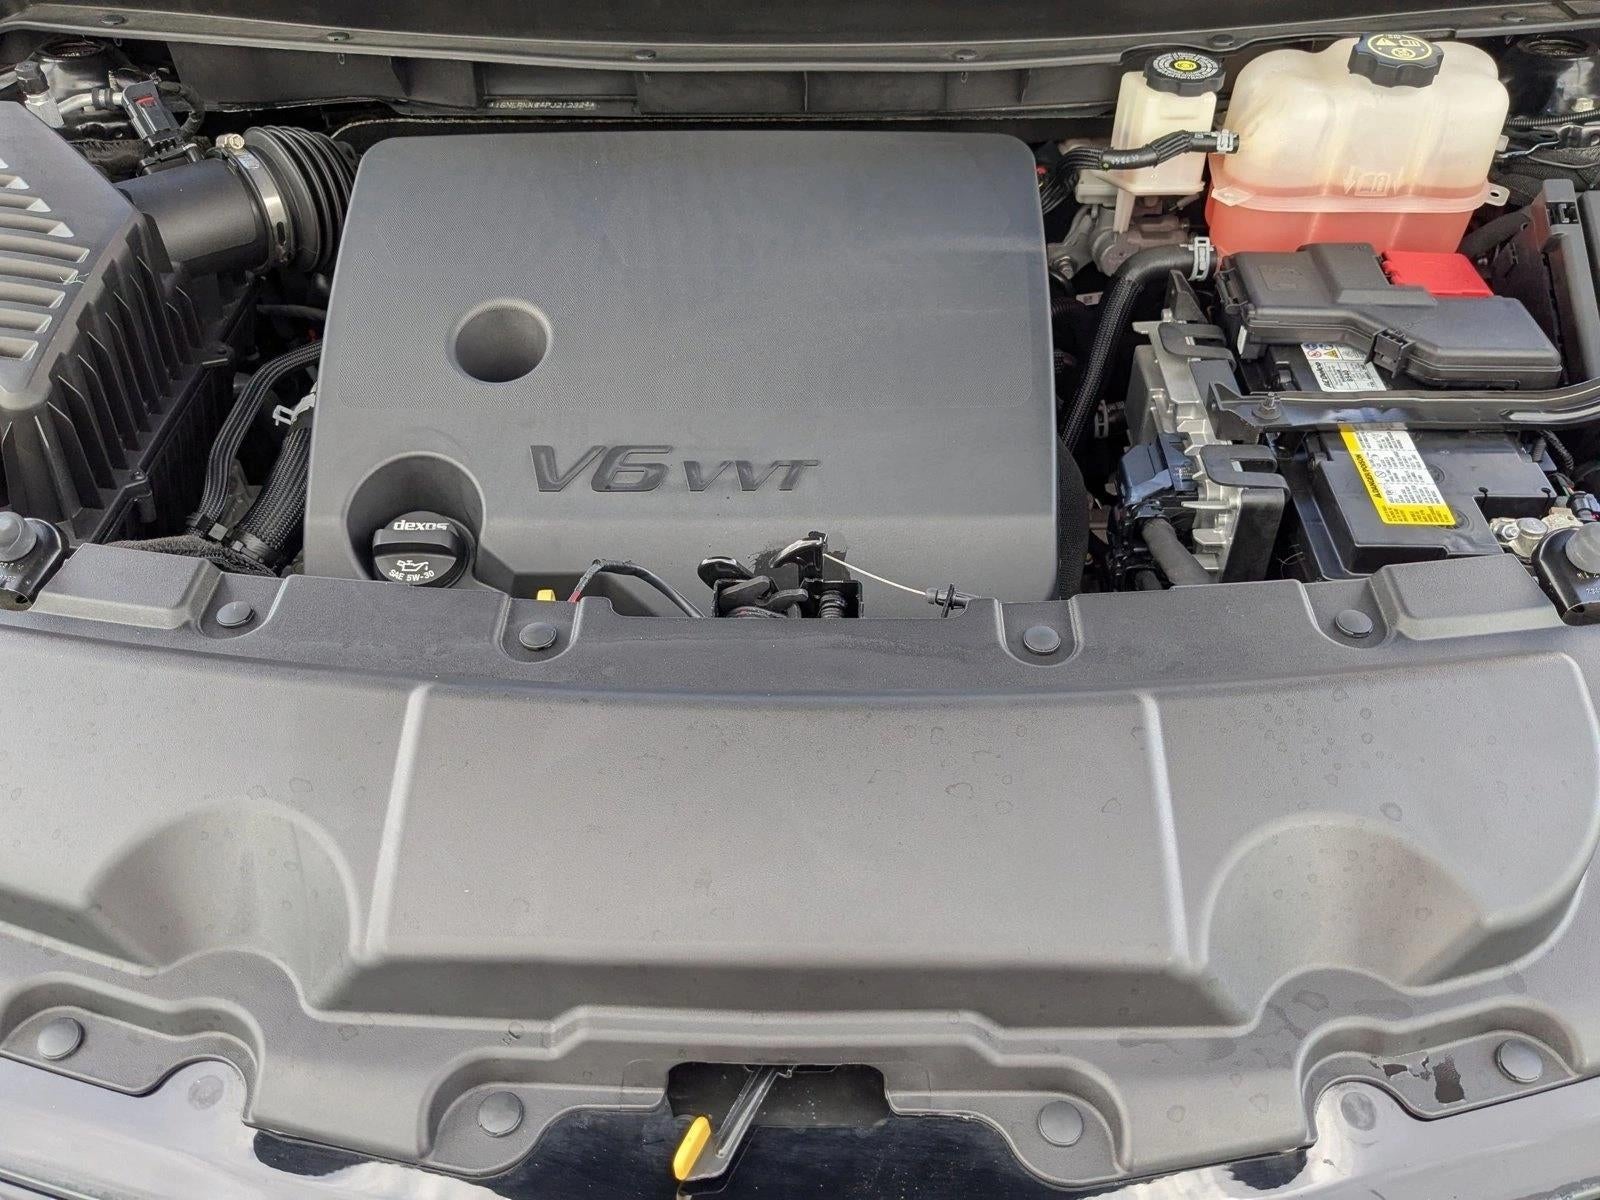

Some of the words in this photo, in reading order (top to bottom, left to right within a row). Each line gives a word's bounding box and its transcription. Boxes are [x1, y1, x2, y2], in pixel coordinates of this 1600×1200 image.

[529, 444, 674, 493] V6
[682, 459, 820, 492] VVT
[393, 519, 450, 531] dexos
[388, 569, 405, 581] SAE
[406, 570, 435, 582] 5W-30
